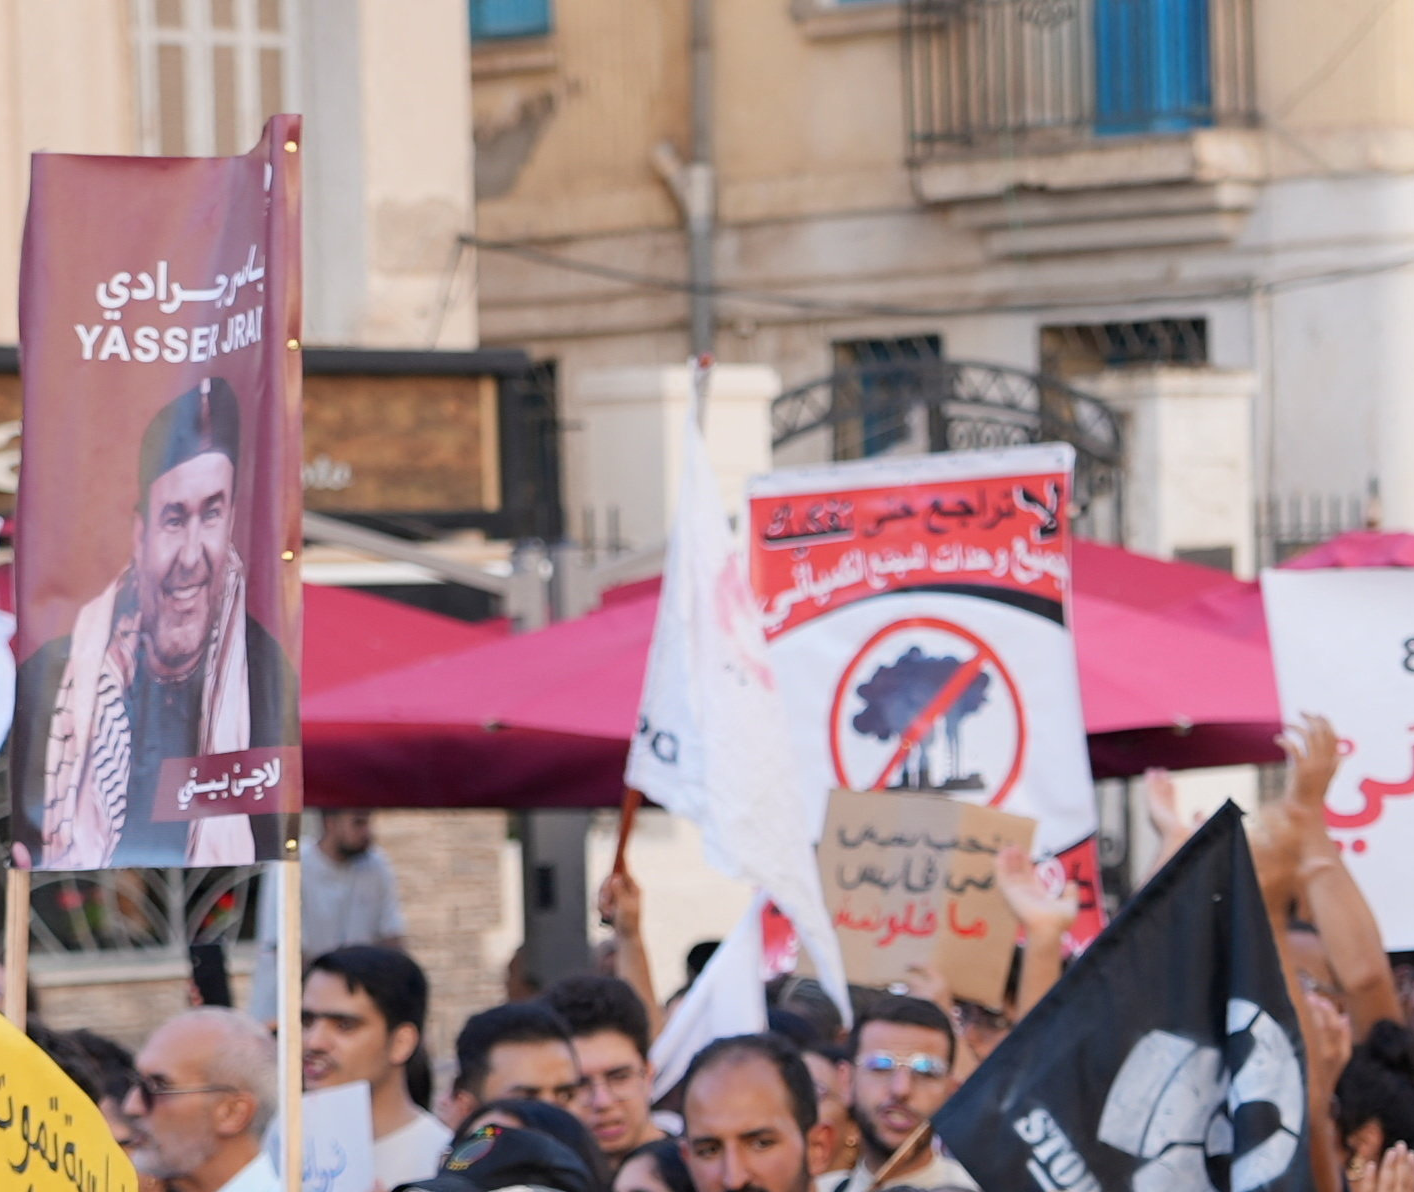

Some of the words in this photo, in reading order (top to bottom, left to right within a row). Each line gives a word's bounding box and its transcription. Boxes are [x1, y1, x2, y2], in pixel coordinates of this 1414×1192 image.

[95, 259, 230, 321] جرادي
[73, 323, 220, 364] YASSER
[1011, 480, 1061, 543] لا
